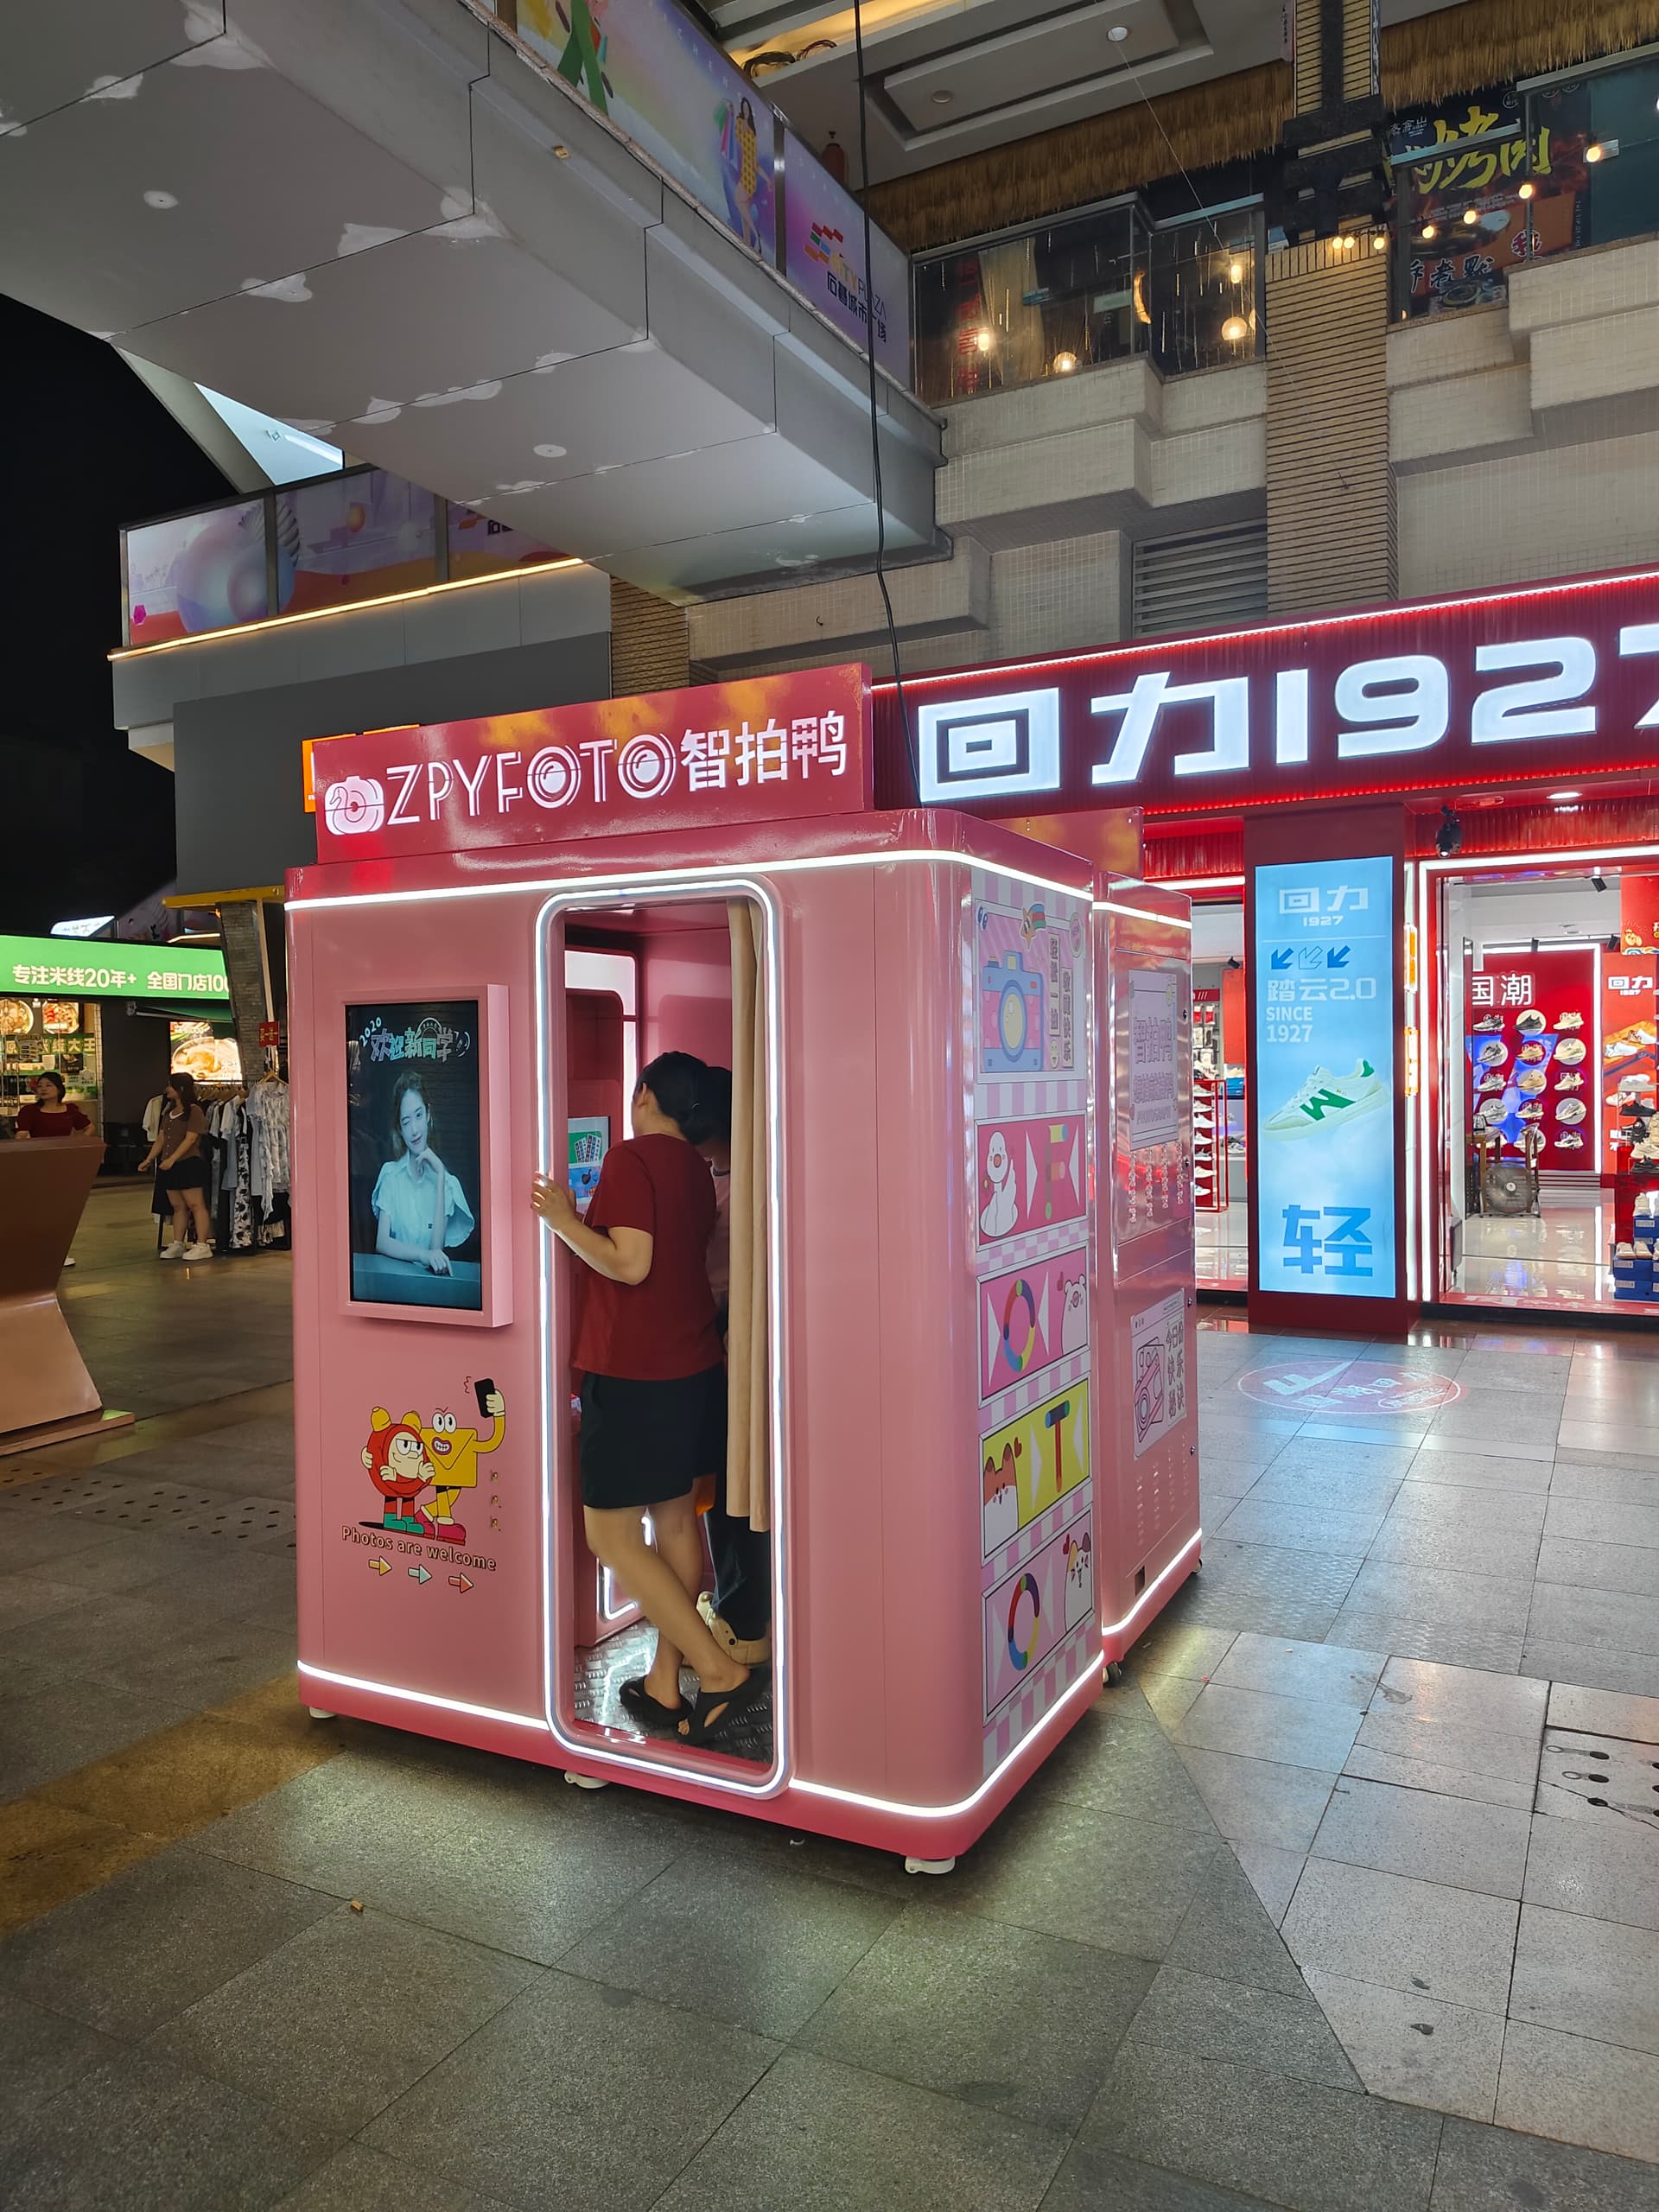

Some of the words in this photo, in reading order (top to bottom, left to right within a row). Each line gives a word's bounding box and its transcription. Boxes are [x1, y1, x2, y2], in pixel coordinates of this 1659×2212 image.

[680, 710, 847, 792] 智拍鸭
[386, 733, 677, 825] ZPYFOTO
[1279, 884, 1369, 914] 回力
[1302, 915, 1344, 927] 1927
[1267, 976, 1377, 1002] 踏云2.0
[1266, 1006, 1313, 1022] SINCE
[359, 1016, 382, 1047] 2020
[1266, 1025, 1313, 1044] 1927
[1282, 1204, 1374, 1278] 轻
[341, 1525, 393, 1550] Photos
[397, 1540, 423, 1556] are
[426, 1545, 497, 1572] welcome
